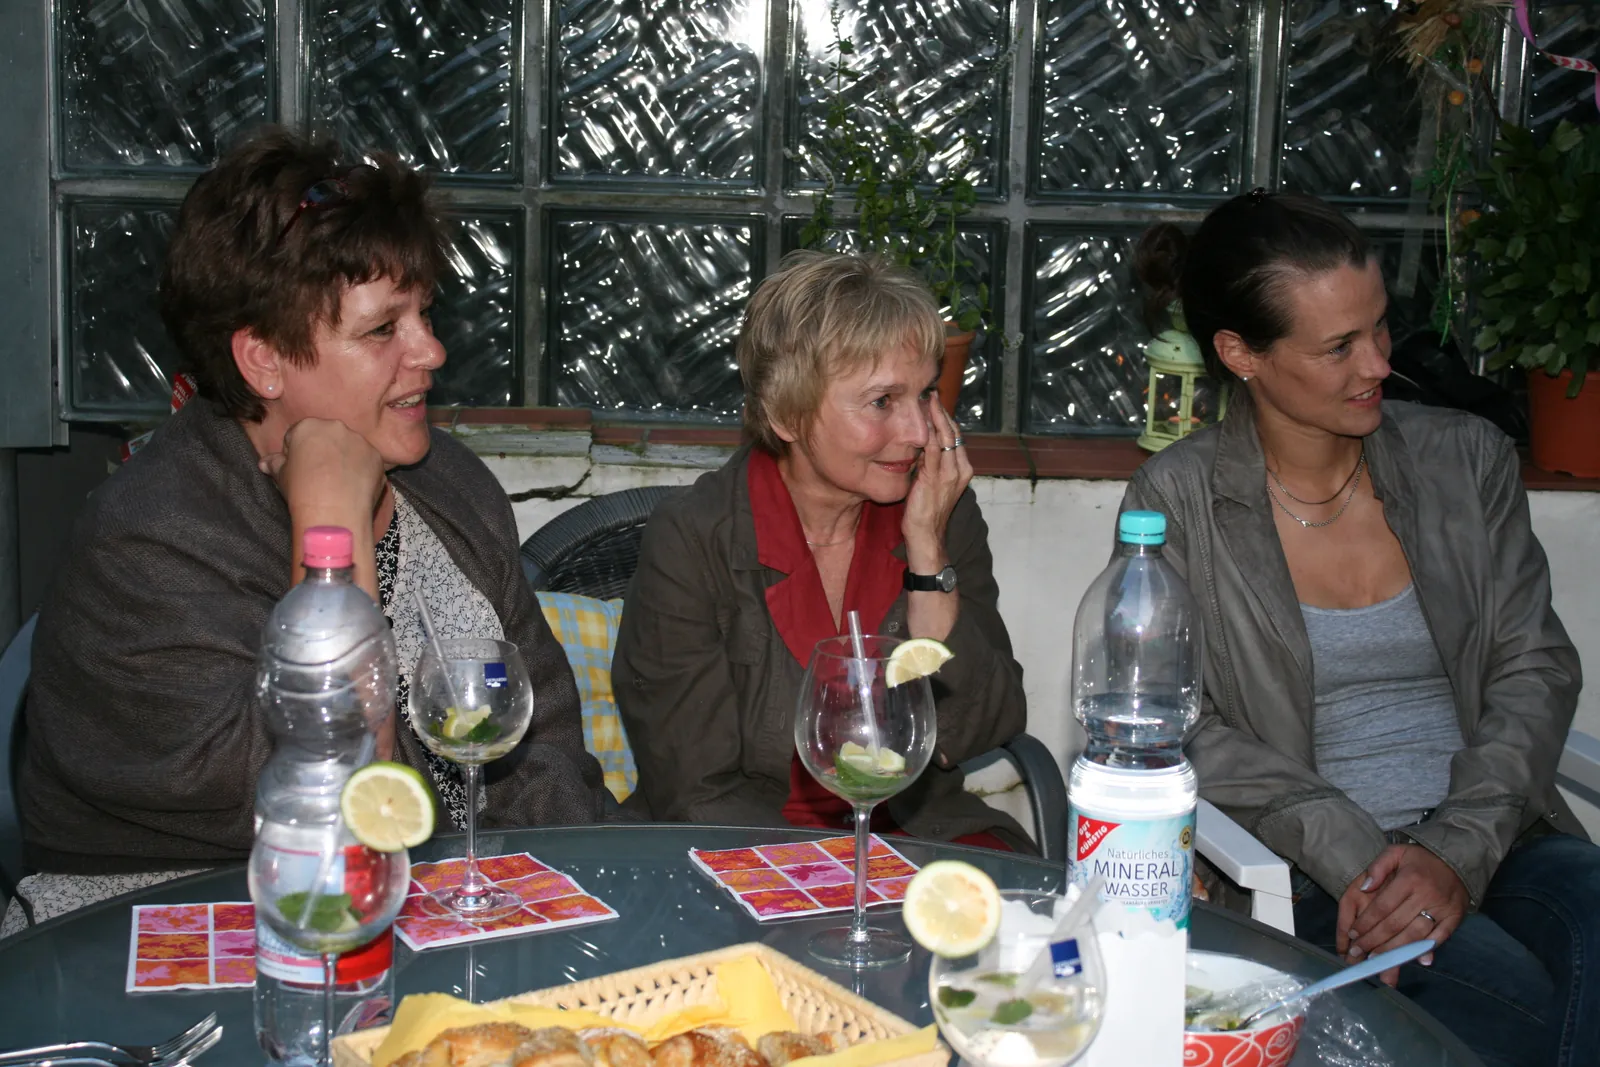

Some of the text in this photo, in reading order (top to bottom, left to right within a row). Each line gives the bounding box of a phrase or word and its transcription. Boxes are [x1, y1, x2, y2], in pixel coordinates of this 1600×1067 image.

[1079, 820, 1091, 836] GUT
[1086, 831, 1091, 839] &
[1080, 825, 1108, 854] GÜNSTIG
[1094, 859, 1179, 880] MINERAL
[1104, 882, 1169, 897] WASSER
